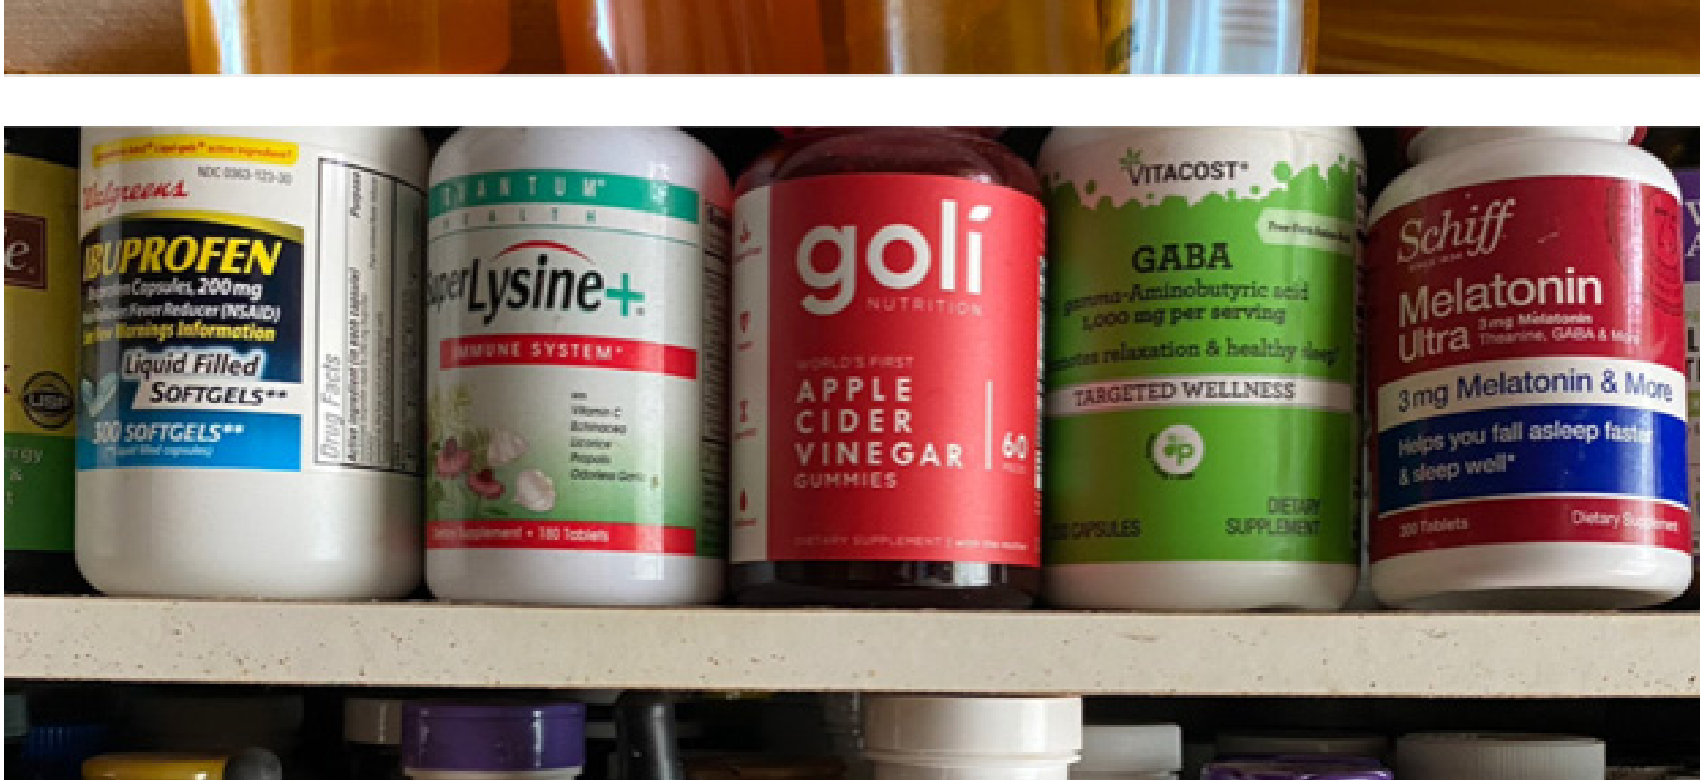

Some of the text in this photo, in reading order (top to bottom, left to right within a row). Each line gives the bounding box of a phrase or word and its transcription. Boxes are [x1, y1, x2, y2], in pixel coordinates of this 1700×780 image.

[1396, 199, 1517, 265] Schiff
[796, 199, 992, 316] goli
[1132, 243, 1234, 274] GABA
[867, 298, 984, 316] NUTRITION
[1399, 267, 1603, 329] Melatonin
[1135, 307, 1166, 327] mg
[1170, 305, 1206, 325] per
[1211, 303, 1286, 324] serving
[1518, 310, 1593, 325] Melatonin
[177, 320, 276, 342] Information
[1398, 324, 1470, 364] Ultra
[1552, 327, 1595, 342] GABA
[1102, 340, 1200, 366] relaxation
[1206, 341, 1220, 357] &
[1226, 338, 1297, 363] healthy
[124, 353, 260, 379] Liquid Filled
[796, 376, 913, 403] APPLE
[1074, 381, 1297, 406] TARGETED WELLNESS
[1457, 367, 1594, 402] Melatonin
[1600, 369, 1618, 394] &
[1625, 369, 1673, 402] More
[321, 353, 344, 459] Drug Facts
[795, 408, 913, 434] CIDER
[1002, 432, 1028, 461] 60
[1399, 432, 1445, 457] Helps
[1448, 428, 1485, 450] you
[1492, 422, 1522, 442] fall
[1529, 420, 1600, 444] asleep
[794, 441, 964, 469] VINEGAR
[794, 471, 898, 490] GUMMIES
[1399, 470, 1410, 487] &
[1413, 462, 1459, 483] sleep
[1268, 496, 1322, 515] DIETARY
[1226, 517, 1321, 537] SUPPLEMENT
[1421, 518, 1469, 533] Tablets
[1571, 509, 1620, 530] Dietary
[564, 528, 609, 543] Tablets
